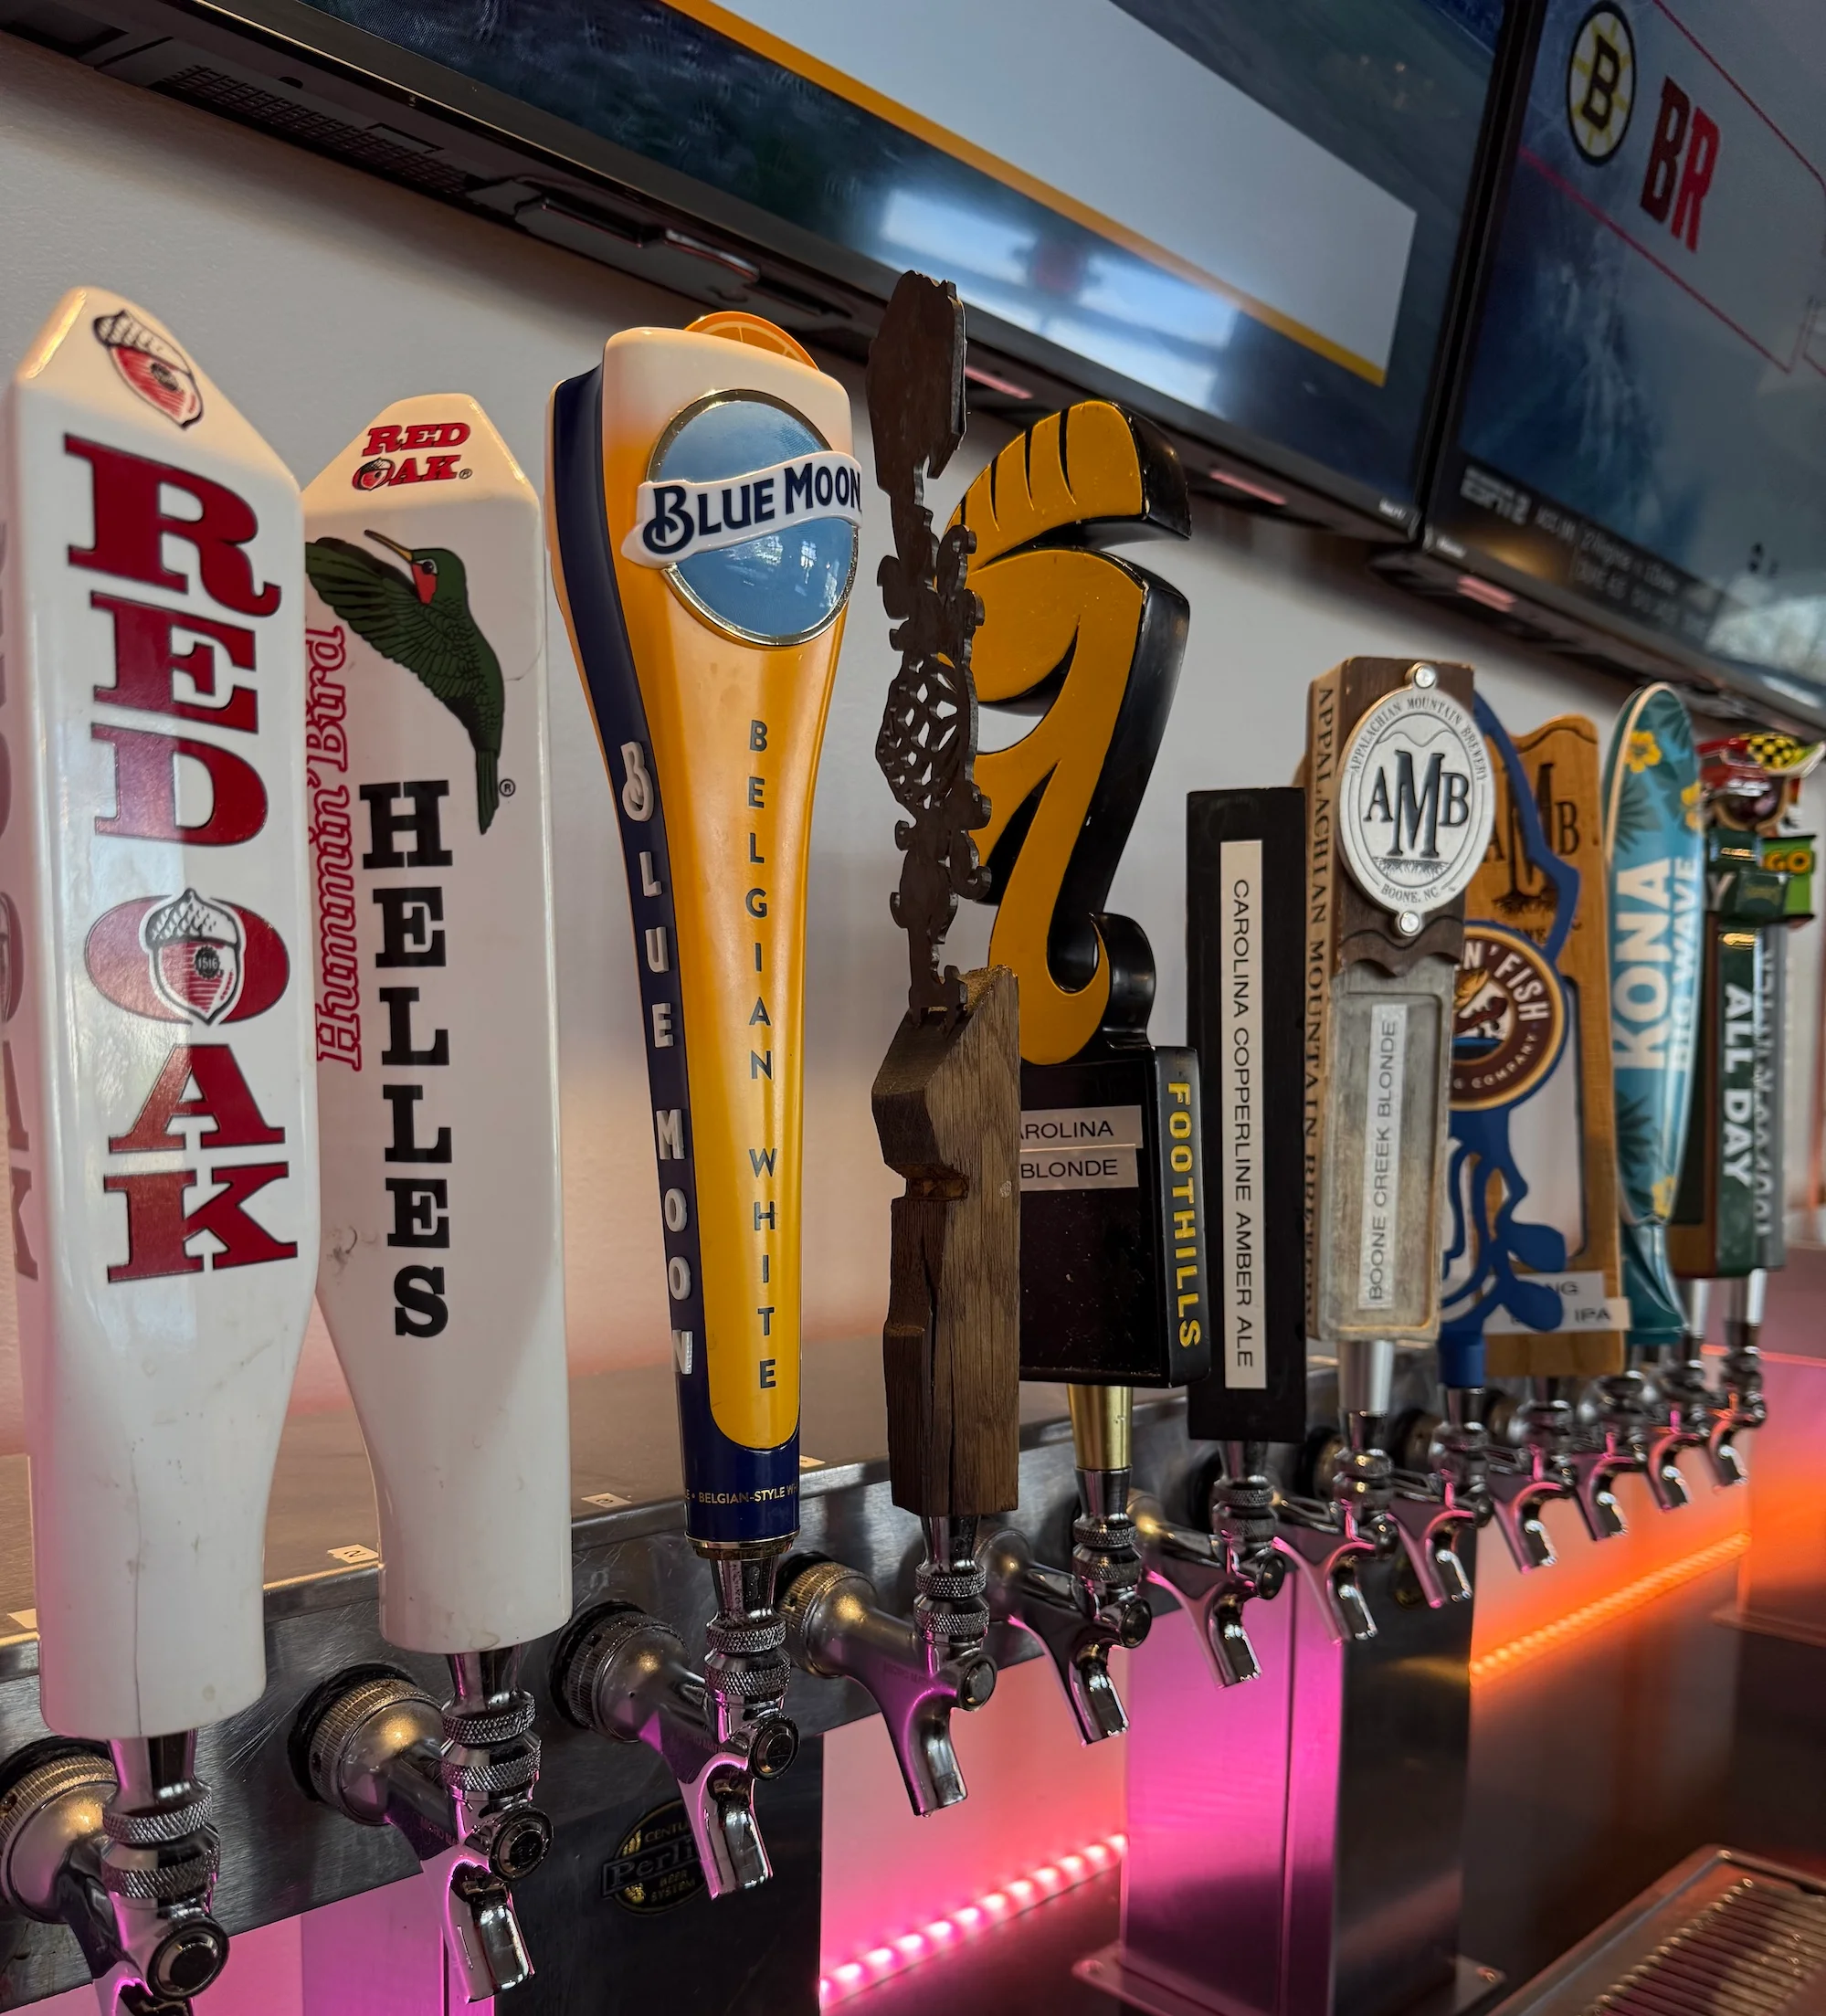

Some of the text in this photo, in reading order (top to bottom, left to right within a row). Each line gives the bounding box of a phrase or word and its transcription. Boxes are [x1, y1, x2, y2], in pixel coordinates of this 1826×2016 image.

[1581, 34, 1620, 131] B
[1641, 76, 1720, 254] BR
[352, 455, 461, 491] OAK
[361, 422, 471, 457] RED
[642, 462, 862, 554] BLUE MOON
[63, 431, 281, 848] RED
[1349, 698, 1487, 782] APPALACHIAN MOUNTAIN BREWERY
[305, 626, 362, 1071] Hummin' Bird
[1309, 688, 1334, 924] APPALACHIAN
[1363, 749, 1470, 858] AMB
[1423, 887, 1441, 900] NC
[197, 956, 218, 968] 1516
[1612, 858, 1672, 1070] KONA
[359, 780, 453, 1337] HELLES
[620, 741, 693, 1375] BLUE MOON
[745, 720, 777, 1388] BELGIAN WHITE
[1725, 982, 1753, 1073] ALL
[84, 888, 298, 1283] OAK
[1231, 880, 1253, 1367] CAROLINA COPPERLINE AMBER ALE
[1724, 1091, 1753, 1186] DAY
[1020, 1159, 1118, 1178] BLONDE
[1369, 1019, 1397, 1301] BOONE CREEK BLONDE
[1168, 1082, 1201, 1348] FOOTHILLS
[1574, 1307, 1610, 1323] IPA
[699, 1486, 786, 1504] BELGIAN-STYLE
